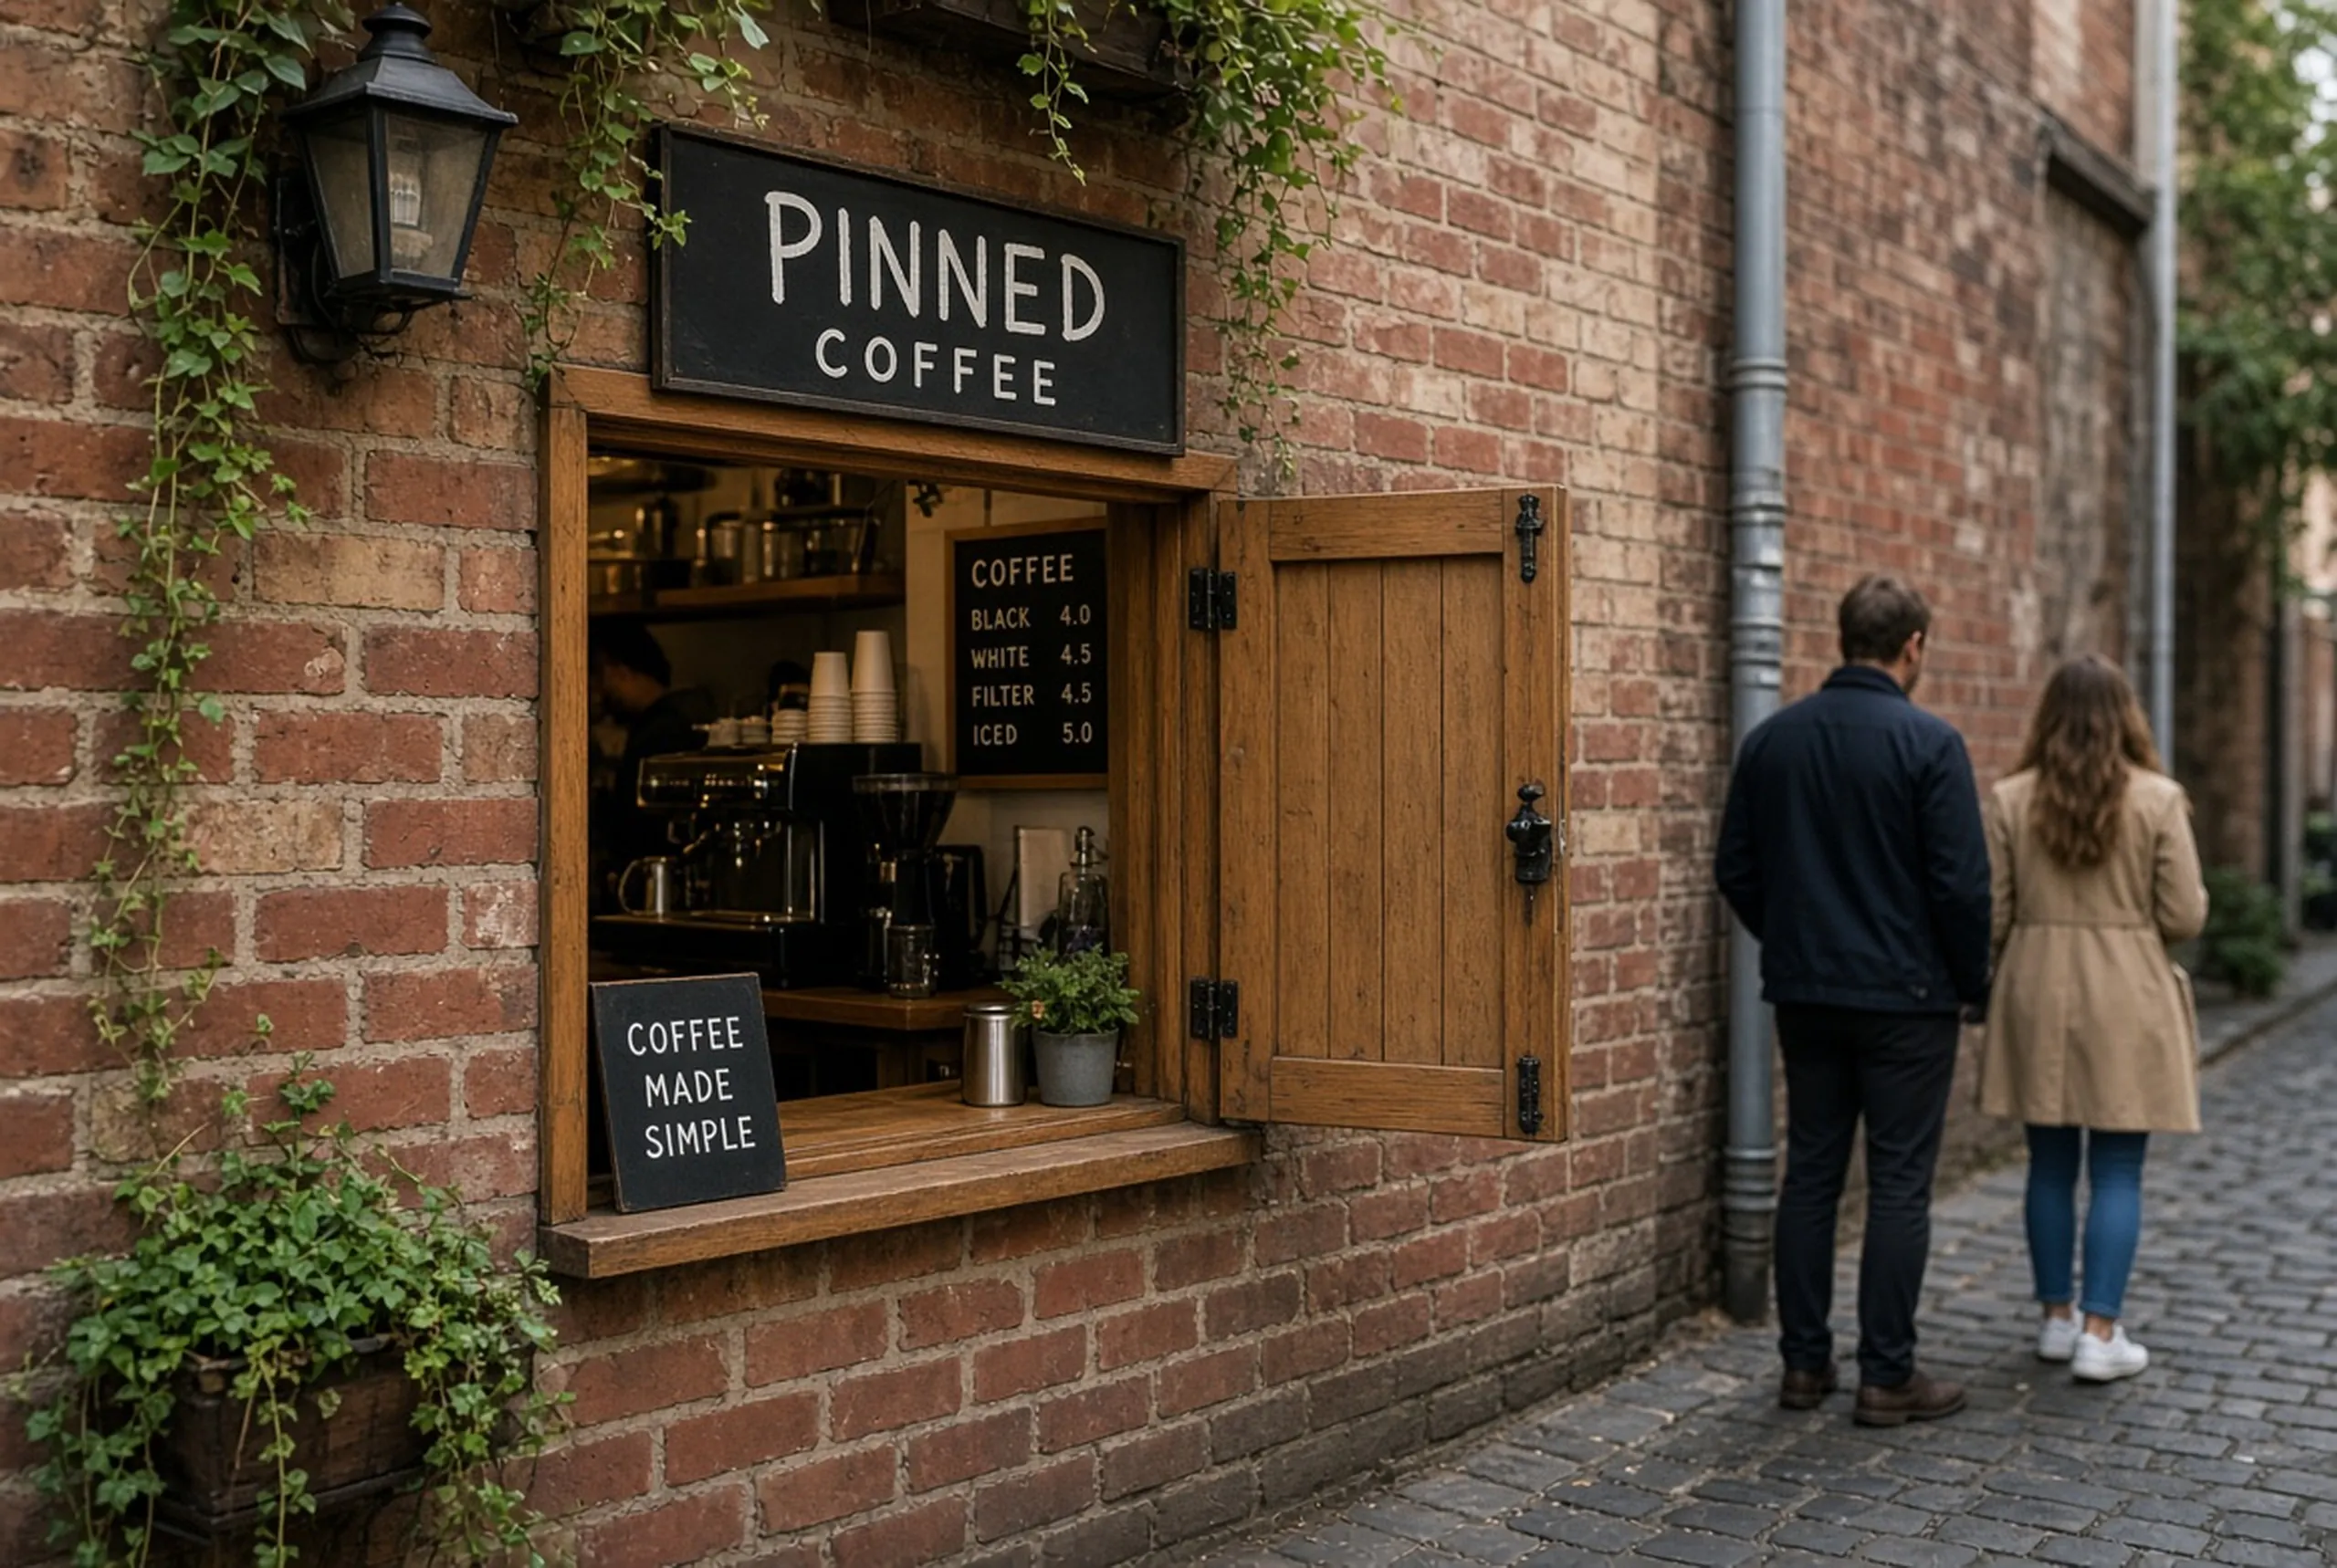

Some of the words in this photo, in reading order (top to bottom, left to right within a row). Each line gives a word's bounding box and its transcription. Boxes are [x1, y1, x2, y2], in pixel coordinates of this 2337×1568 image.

[764, 191, 1105, 341] PINNED
[815, 328, 1056, 406] COFFEE
[971, 554, 1074, 588] COFFEE
[971, 607, 1031, 631] BLACK
[1060, 604, 1091, 625] 4.0
[971, 645, 1030, 668] WHITE
[1060, 643, 1091, 664] 4.5
[972, 685, 1034, 706] FILTER
[1061, 682, 1092, 704] 4.5
[974, 724, 1017, 746] ICED
[1063, 721, 1093, 744] 5.0
[627, 1016, 744, 1056] COFFEE
[645, 1068, 734, 1108] MADE
[645, 1115, 756, 1159] SIMPLE
